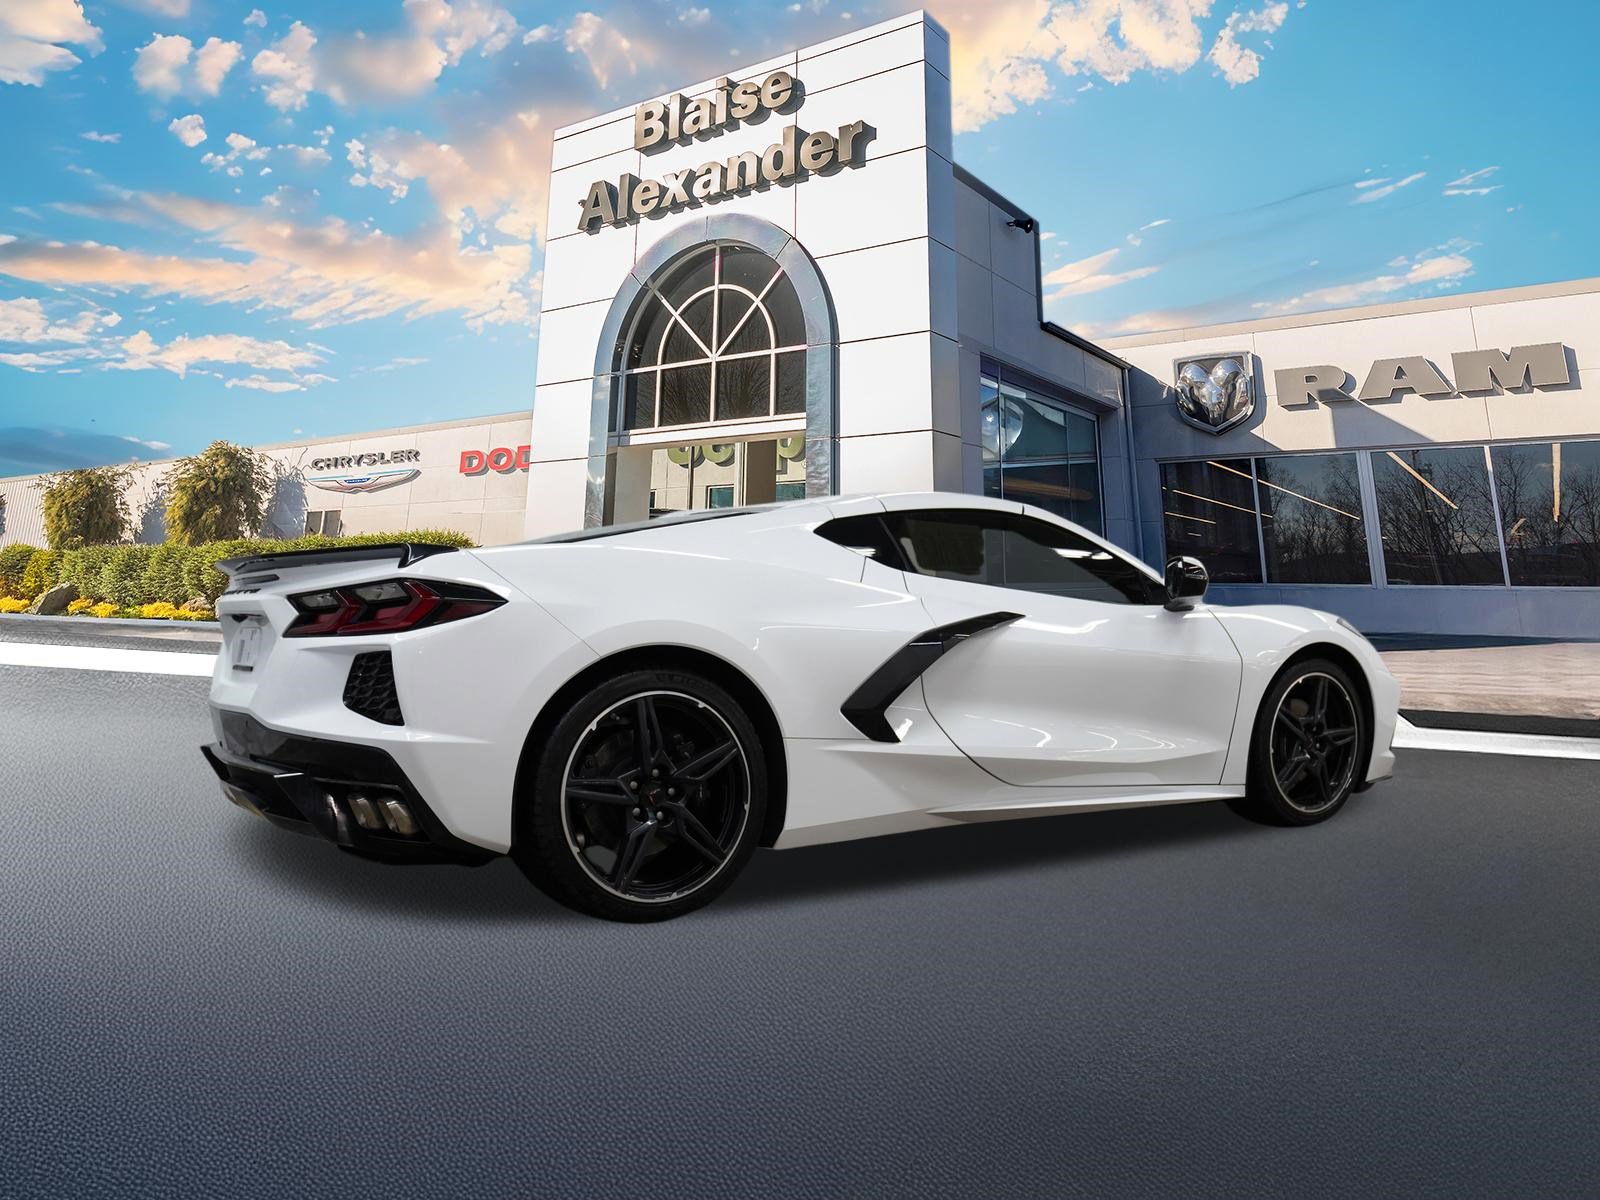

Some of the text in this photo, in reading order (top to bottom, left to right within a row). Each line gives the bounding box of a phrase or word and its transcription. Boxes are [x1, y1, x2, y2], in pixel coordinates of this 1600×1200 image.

[634, 71, 801, 154] Blaise
[578, 119, 873, 232] Alexander
[1274, 342, 1571, 407] RAM
[312, 448, 420, 471] CHRYSLER
